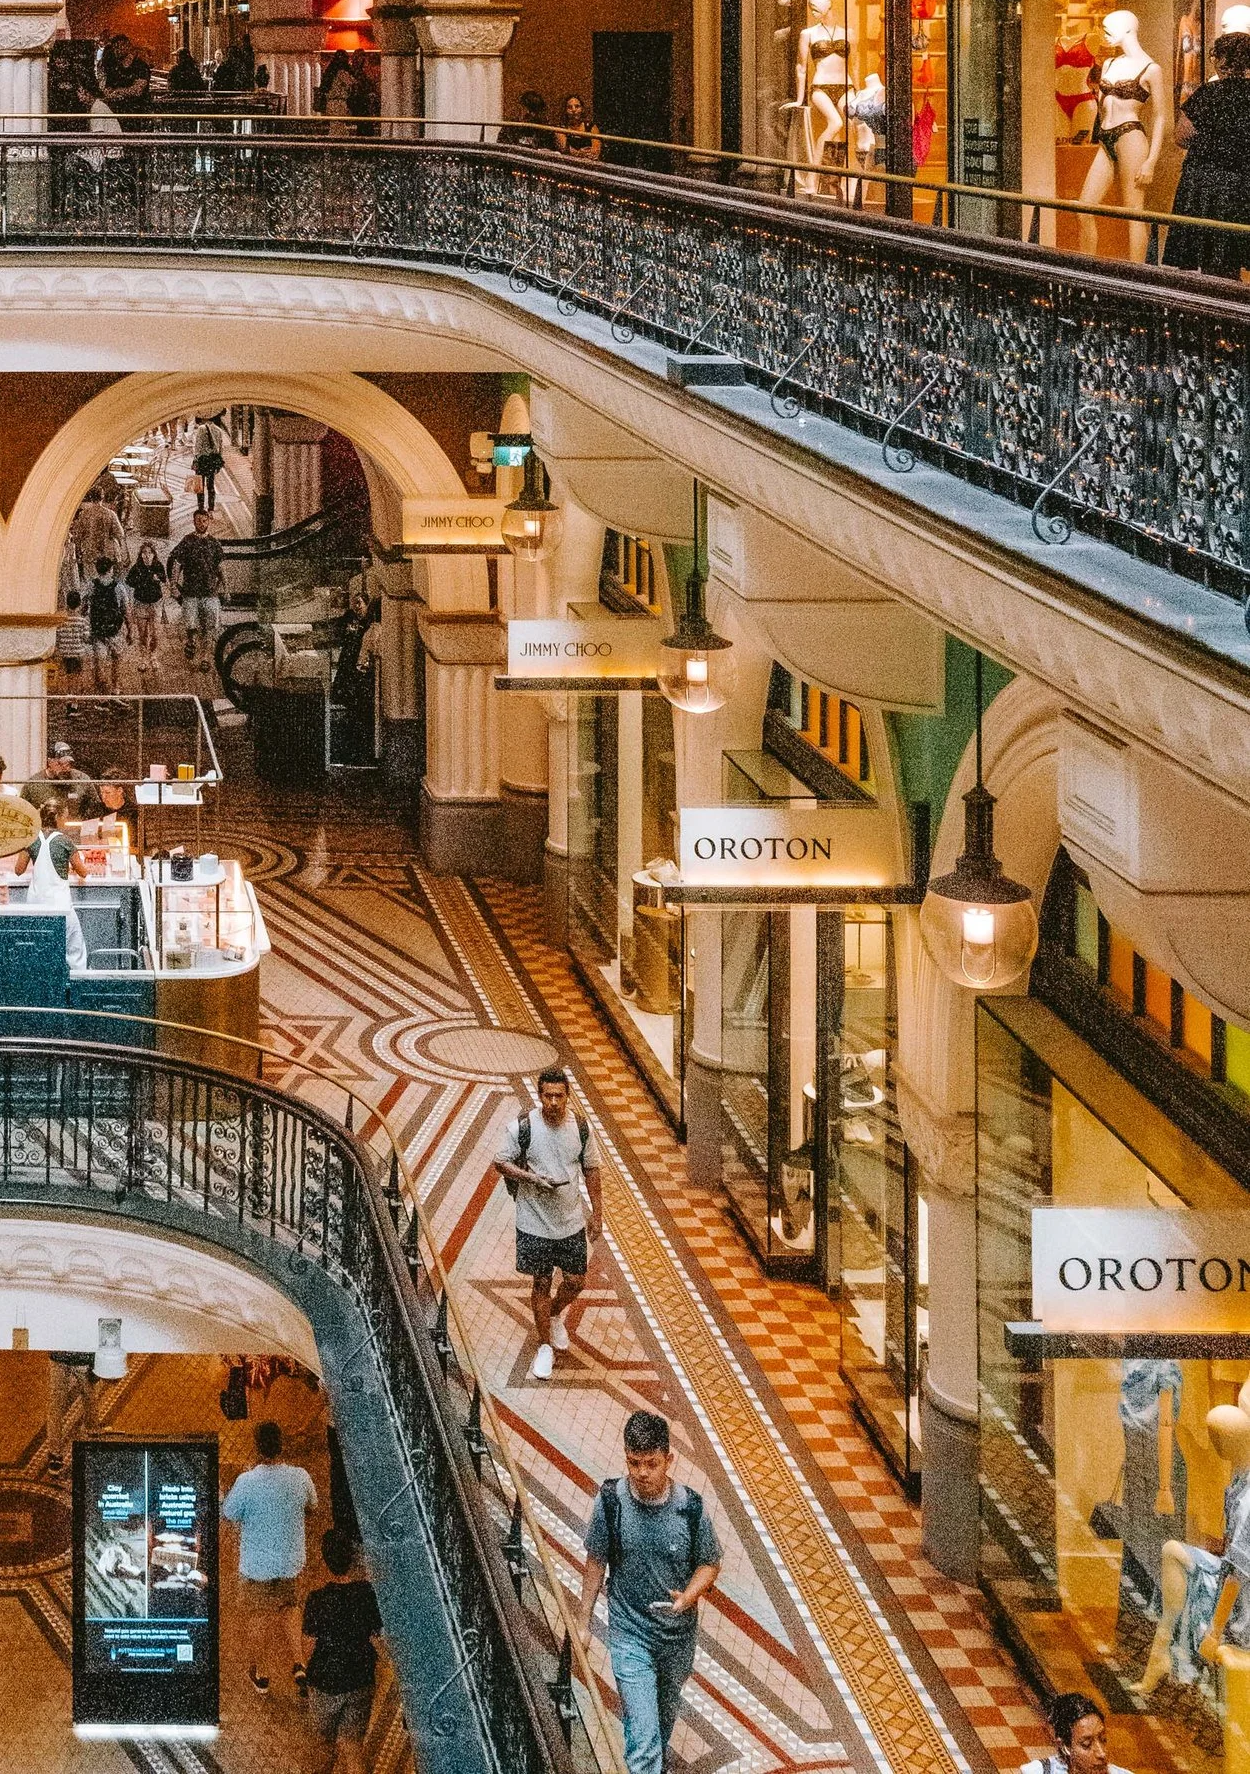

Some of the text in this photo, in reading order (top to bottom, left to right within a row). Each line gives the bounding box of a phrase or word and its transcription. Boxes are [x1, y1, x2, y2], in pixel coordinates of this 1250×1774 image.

[420, 516, 494, 528] JIMMY CHOO
[520, 642, 612, 657] JIMMY CHOO
[694, 837, 832, 860] OROTON
[107, 1485, 122, 1493] Clay
[159, 1493, 196, 1502] bricks using
[161, 1501, 194, 1509] Australian
[160, 1509, 196, 1518] natural gas
